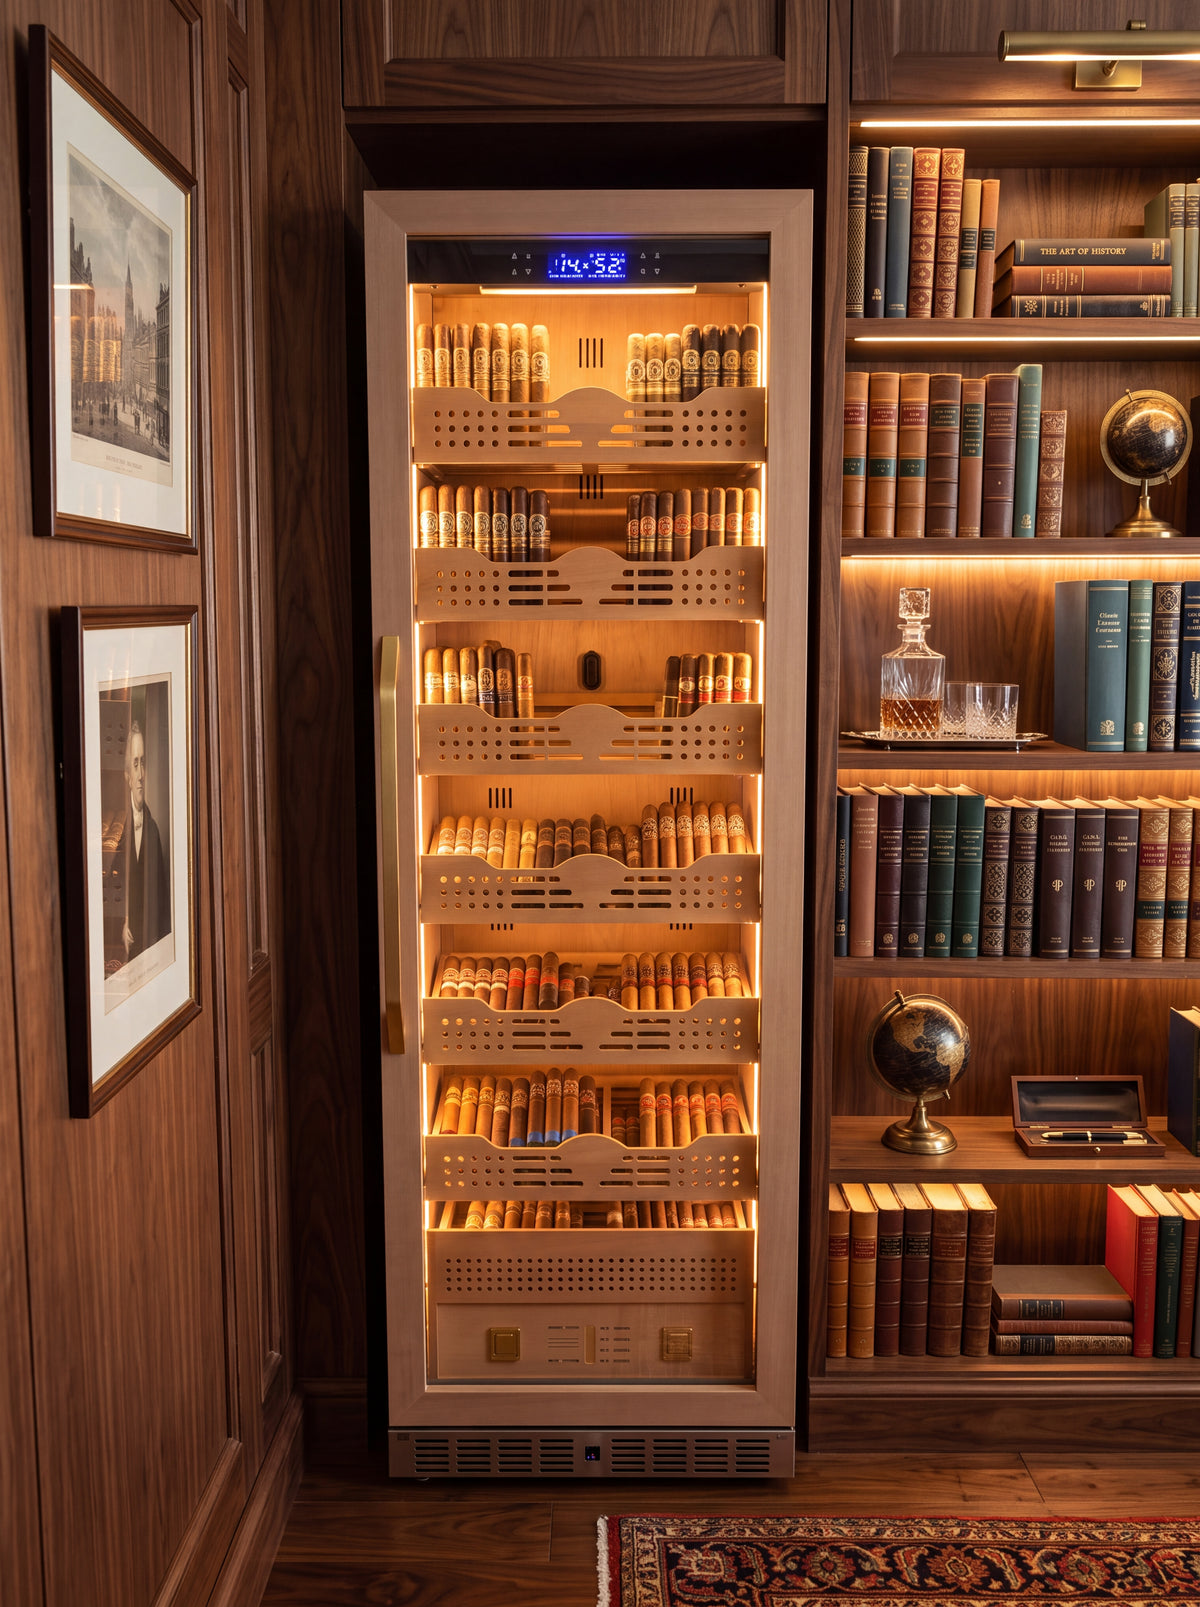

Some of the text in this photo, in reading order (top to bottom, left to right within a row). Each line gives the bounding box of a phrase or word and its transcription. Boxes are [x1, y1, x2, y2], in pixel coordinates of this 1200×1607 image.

[1040, 247, 1126, 255] THE ART OF HISTORY
